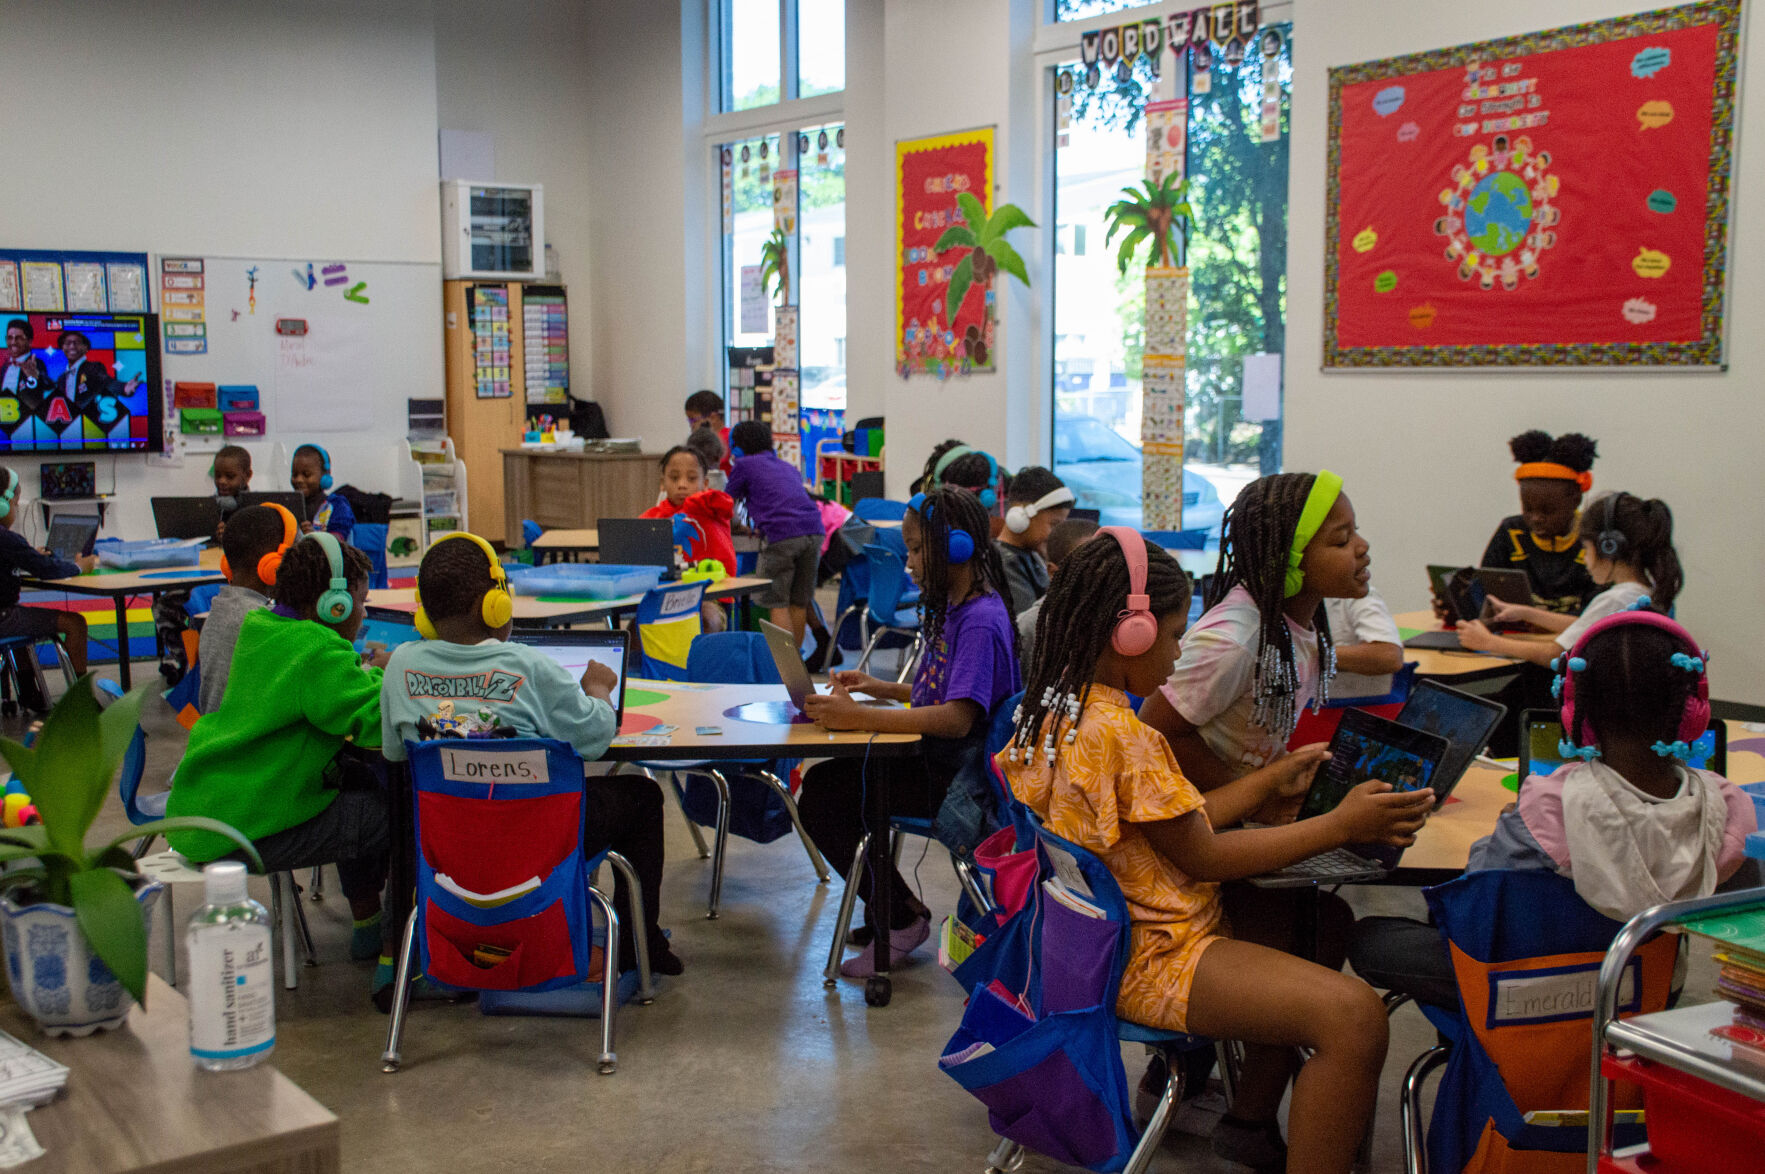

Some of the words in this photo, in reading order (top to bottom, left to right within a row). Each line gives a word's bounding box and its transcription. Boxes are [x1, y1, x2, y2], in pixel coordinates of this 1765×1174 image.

[1083, 25, 1159, 63] WORD
[1170, 6, 1257, 47] WALL
[46, 397, 72, 424] A
[483, 670, 522, 702] Z
[220, 948, 237, 1009] sanitizer
[1505, 981, 1592, 1015] Emerald
[222, 1011, 238, 1046] hand
